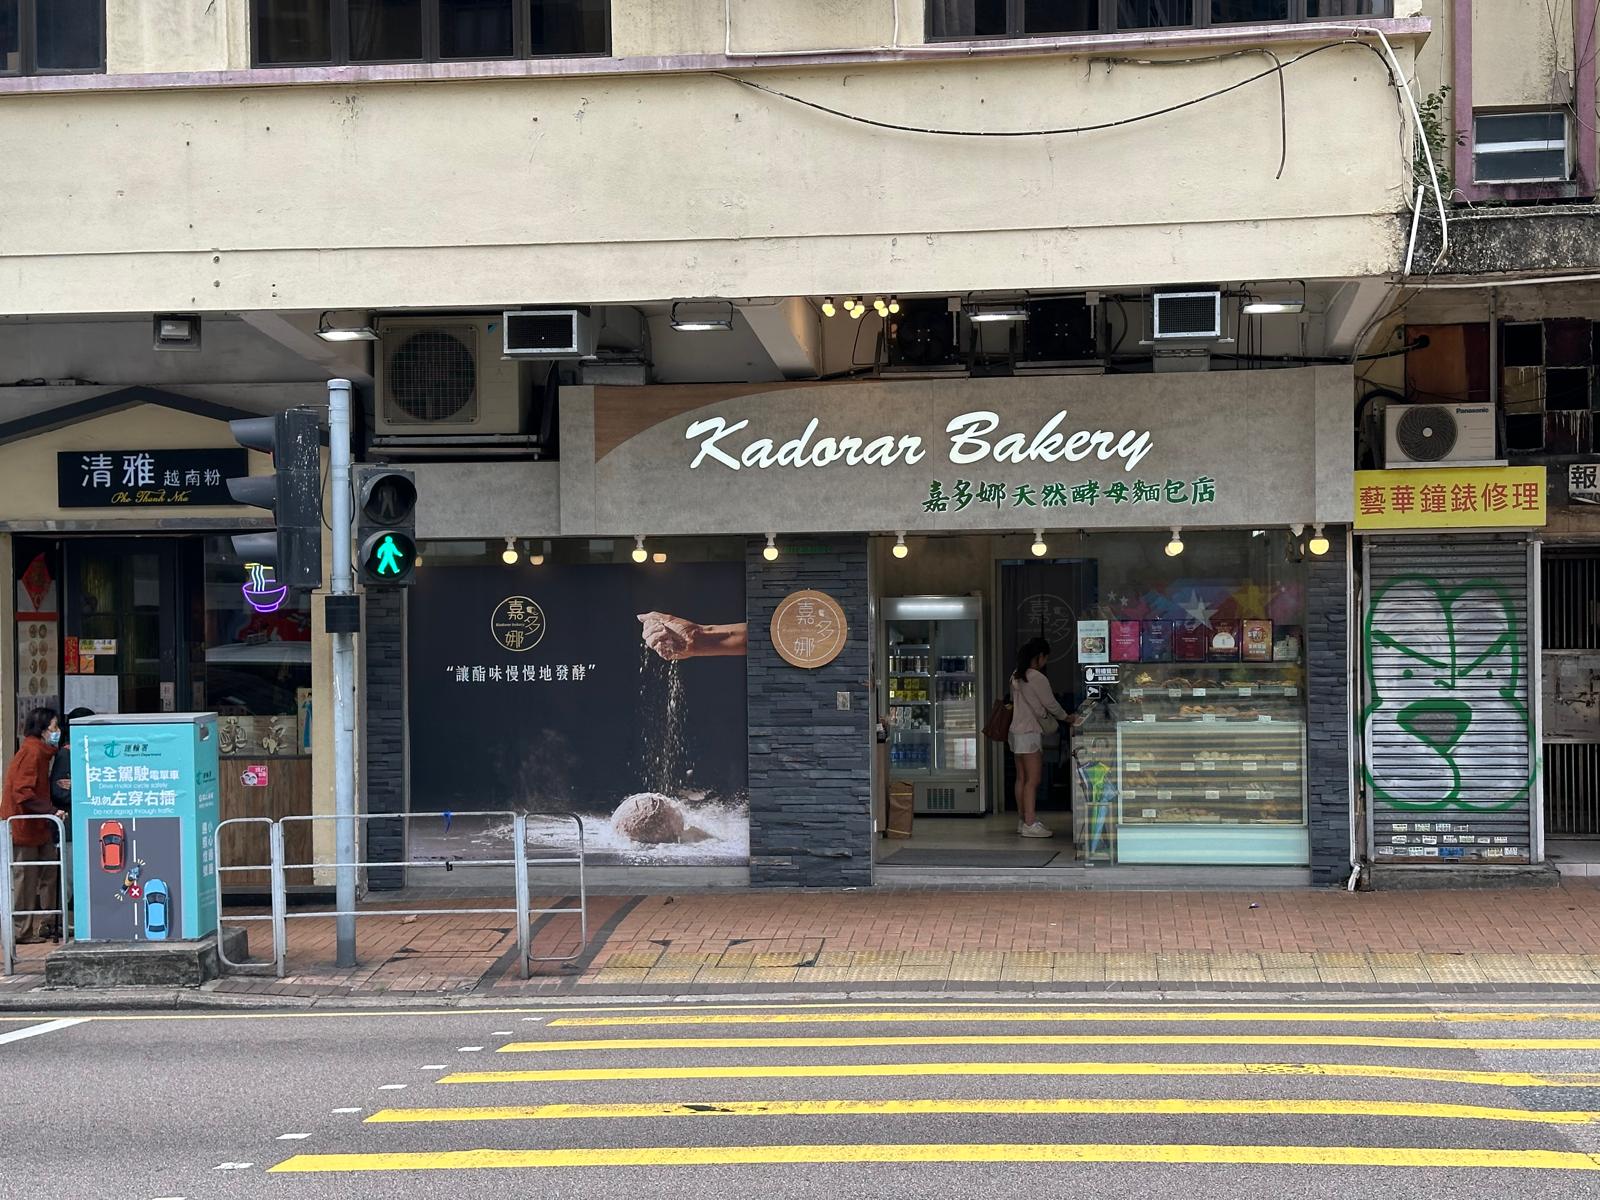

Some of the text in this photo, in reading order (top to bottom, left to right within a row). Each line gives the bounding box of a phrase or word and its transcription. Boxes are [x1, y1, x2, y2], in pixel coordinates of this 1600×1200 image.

[686, 410, 1153, 471] Kadorar Bakery
[81, 453, 221, 488] 清雅 越南粉
[1571, 465, 1597, 489] 報
[135, 488, 166, 504] Thanh
[922, 476, 1216, 513] 嘉多娜天然酵母麵包店
[1359, 482, 1540, 515] 藝華鐘錶修理
[91, 790, 176, 806] 切勿左穿右插
